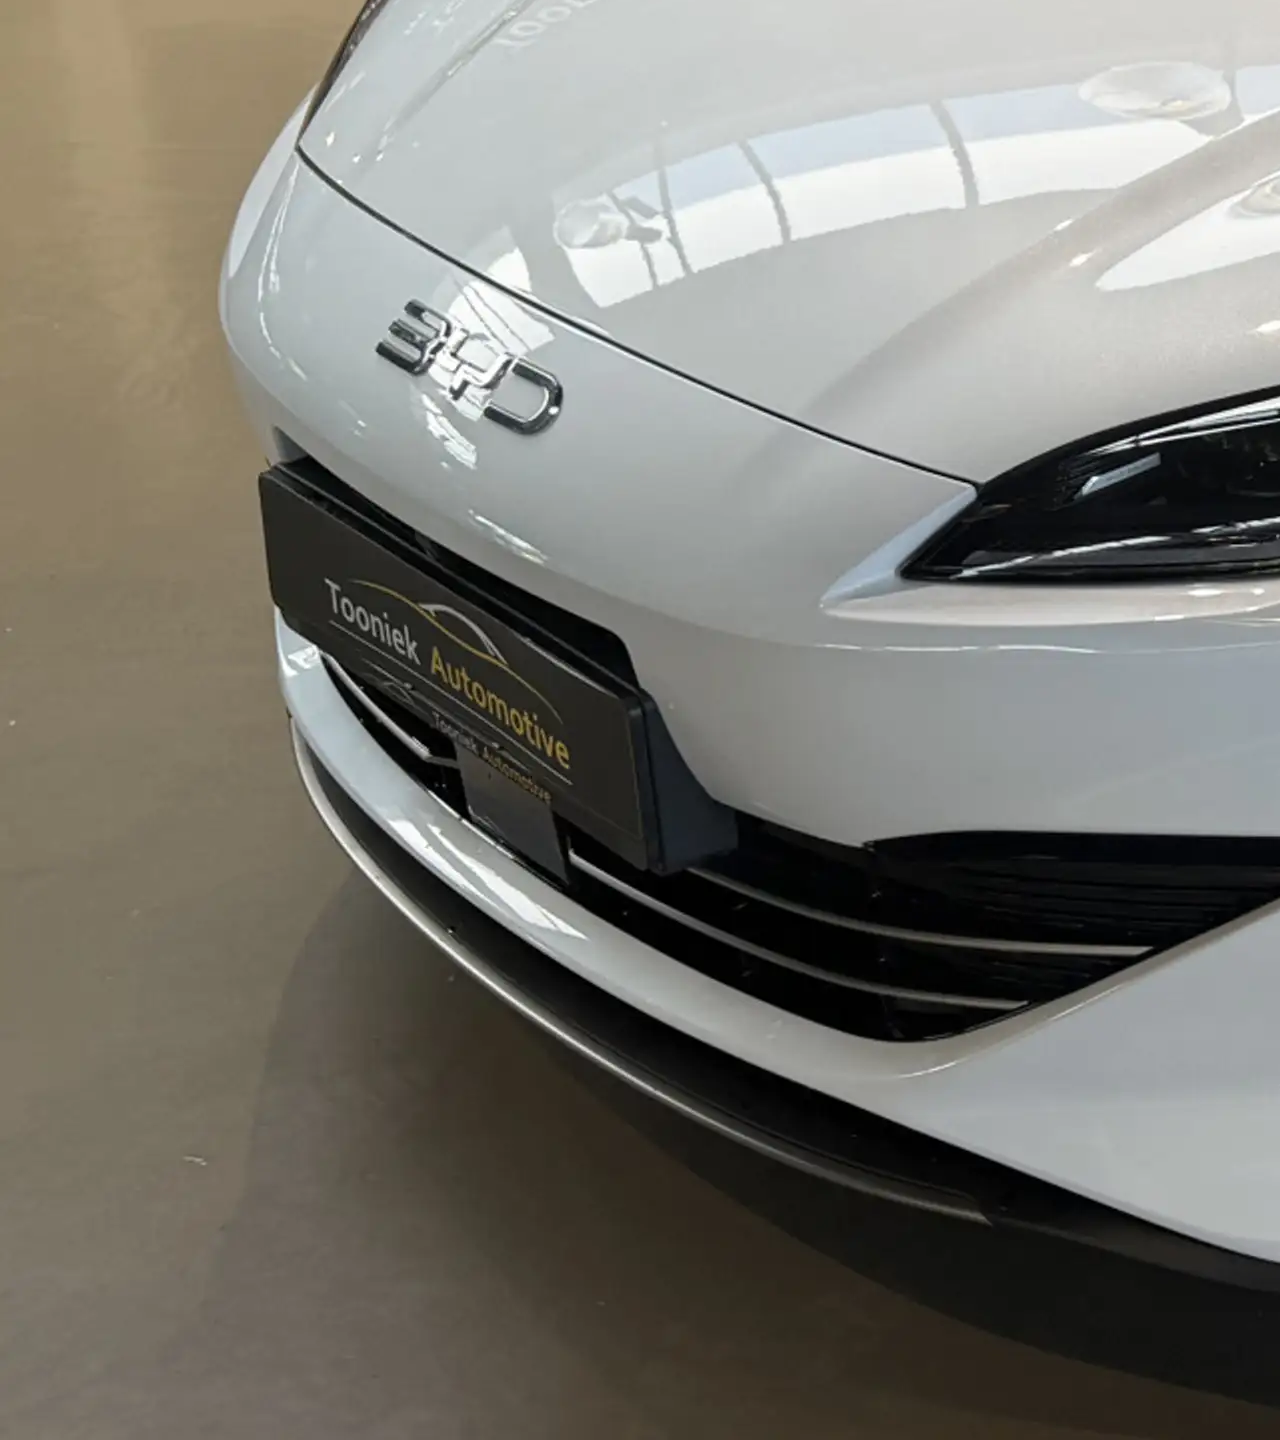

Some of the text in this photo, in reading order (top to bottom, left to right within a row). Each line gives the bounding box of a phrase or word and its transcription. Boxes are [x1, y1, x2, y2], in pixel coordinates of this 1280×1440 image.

[374, 298, 564, 437] BYD
[324, 576, 572, 771] Tooniek Automotive
